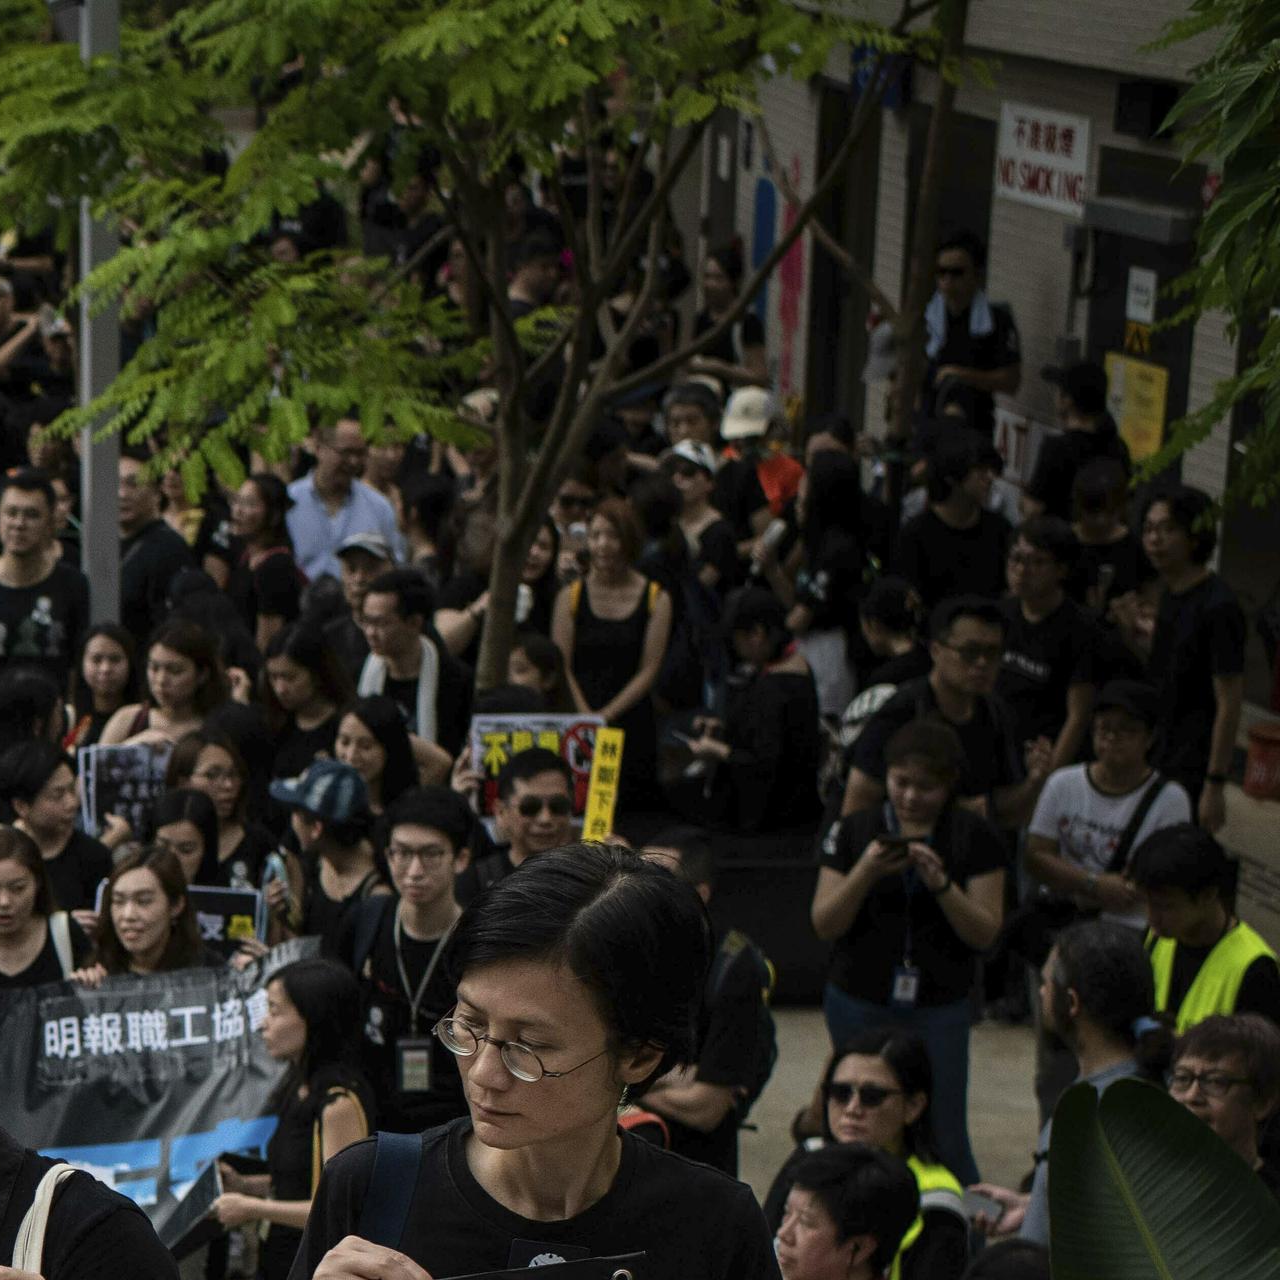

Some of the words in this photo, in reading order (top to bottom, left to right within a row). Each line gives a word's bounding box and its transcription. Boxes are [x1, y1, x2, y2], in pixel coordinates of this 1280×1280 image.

[998, 156, 1015, 188] NO
[1019, 160, 1085, 206] SMOKING
[44, 988, 269, 1058] 明報職工協會
